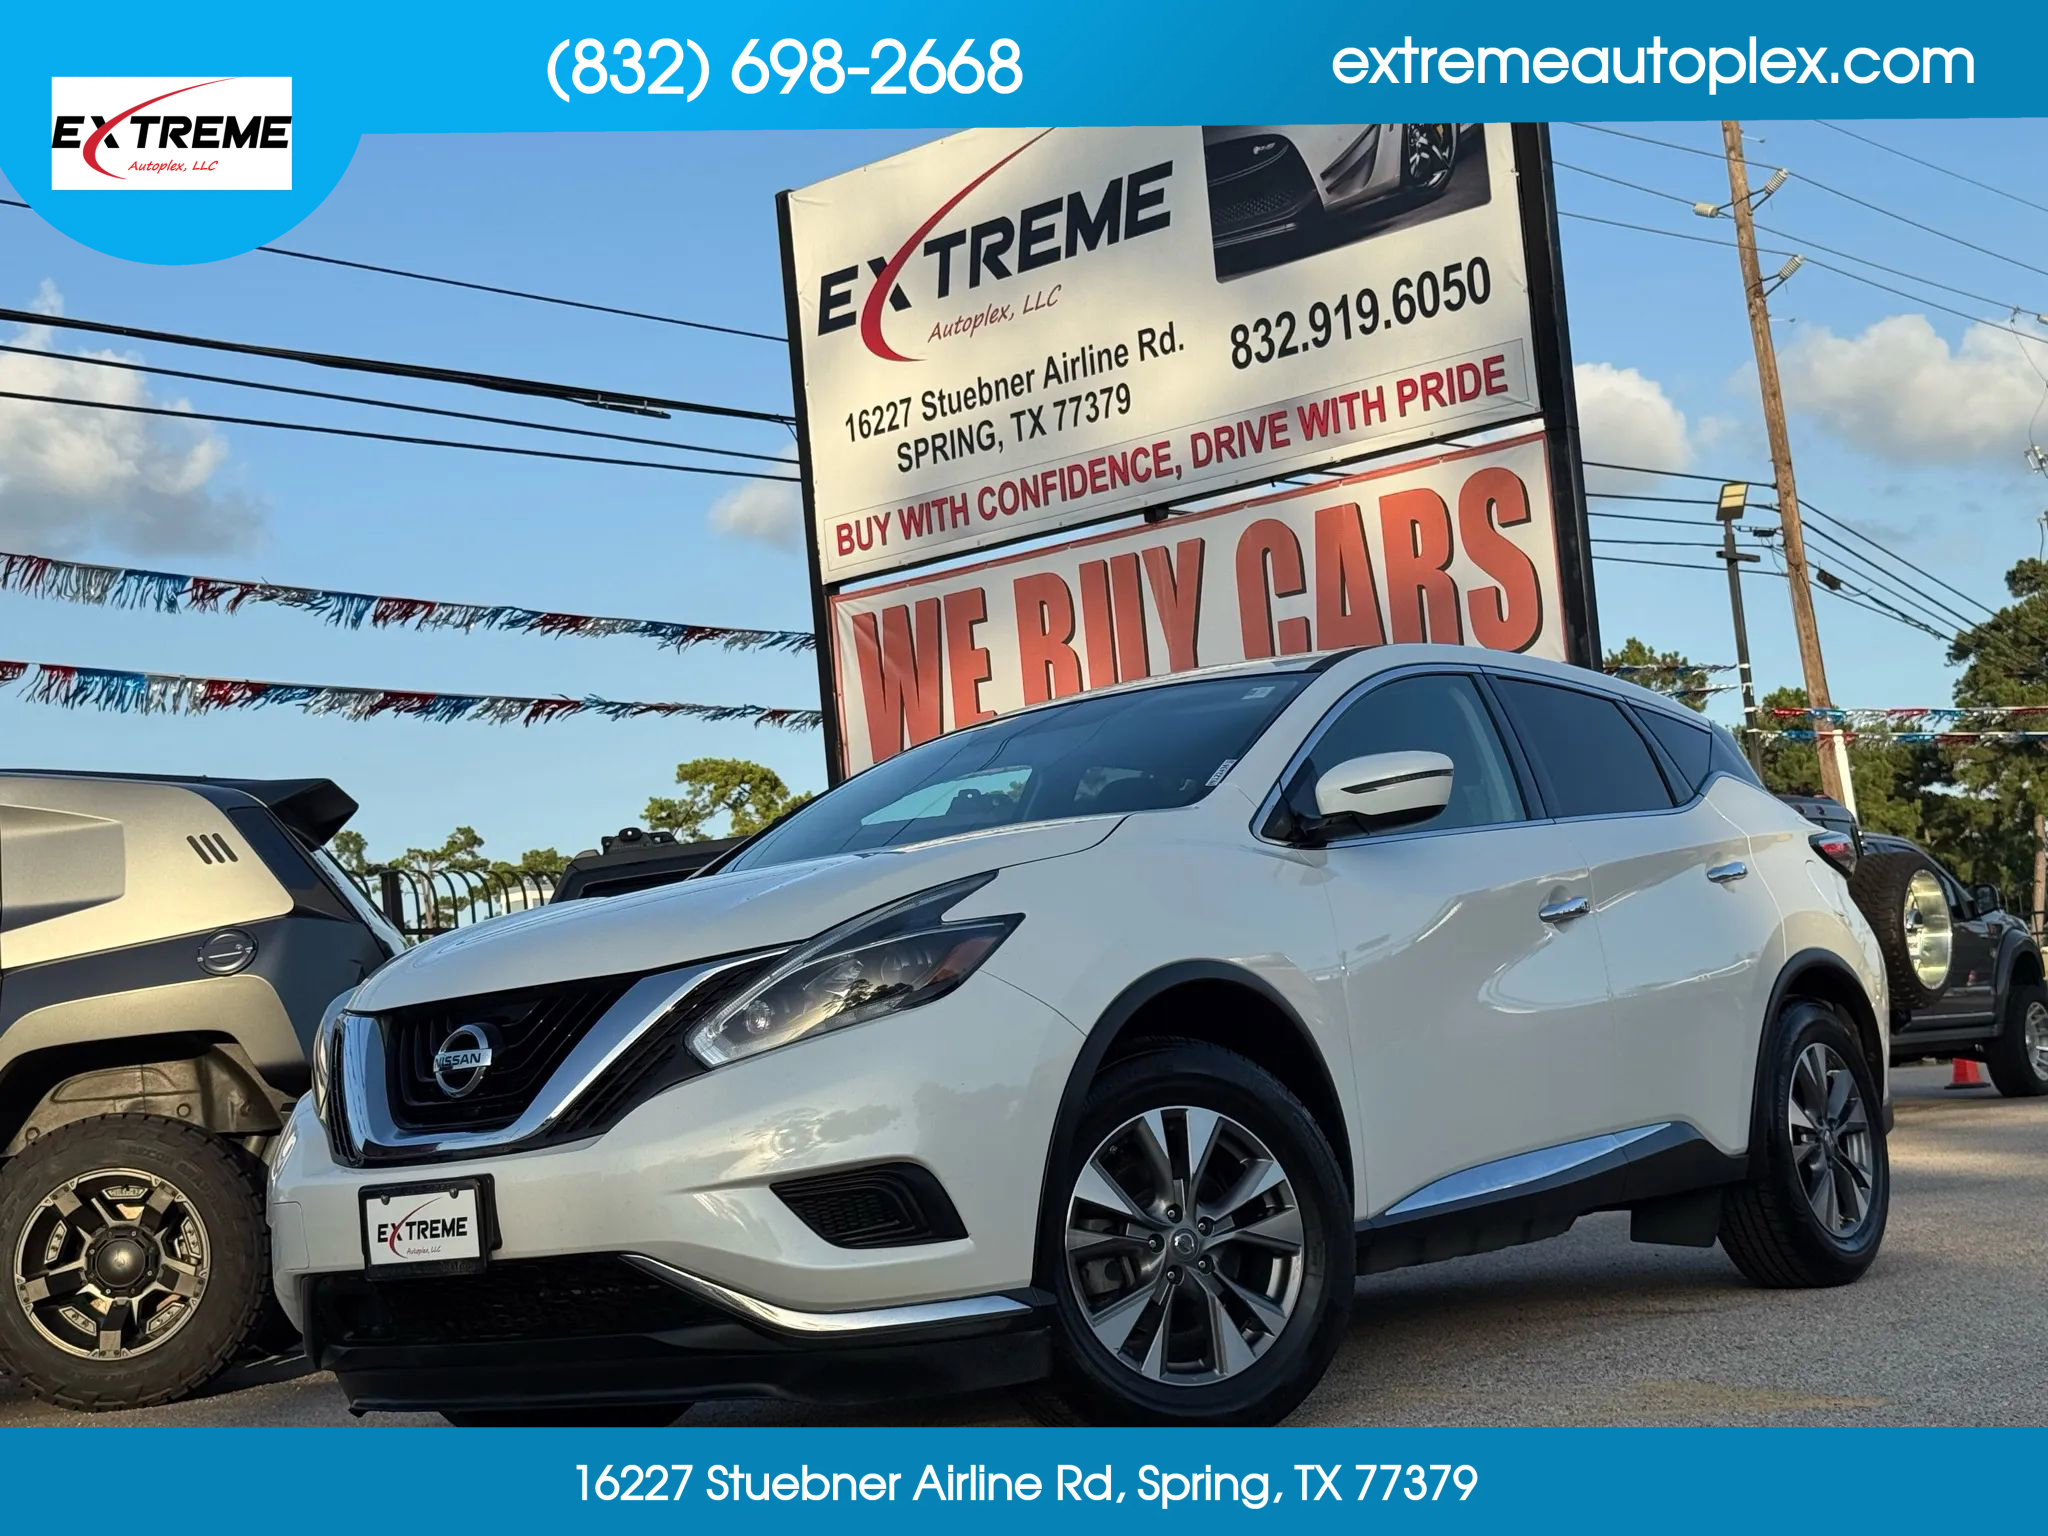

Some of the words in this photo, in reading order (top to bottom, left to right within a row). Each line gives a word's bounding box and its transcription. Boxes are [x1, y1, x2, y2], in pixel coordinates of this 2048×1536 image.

[818, 160, 1173, 337] EXTREME
[928, 302, 1015, 343] Autoplex,
[1022, 284, 1062, 316] LLC
[1229, 256, 1492, 370] 832.919.6050
[845, 397, 912, 443] 16227
[921, 368, 1037, 422] Stuebner
[1043, 343, 1130, 390] Airline
[1138, 321, 1185, 362] Rd.
[897, 419, 1004, 473] SPRING,
[1010, 405, 1048, 442] TX
[1053, 382, 1132, 432] 77379
[836, 512, 891, 556] BUY
[897, 493, 970, 540] WITH
[977, 440, 1183, 521] CONFIDENCE,
[1190, 410, 1290, 469] DRIVE
[1297, 385, 1387, 441] WITH
[1396, 354, 1508, 417] PRIDE
[851, 587, 996, 764] WE
[1236, 467, 1544, 659] CARS
[435, 1053, 481, 1067] NISSAN
[377, 1216, 468, 1243] EXTREME
